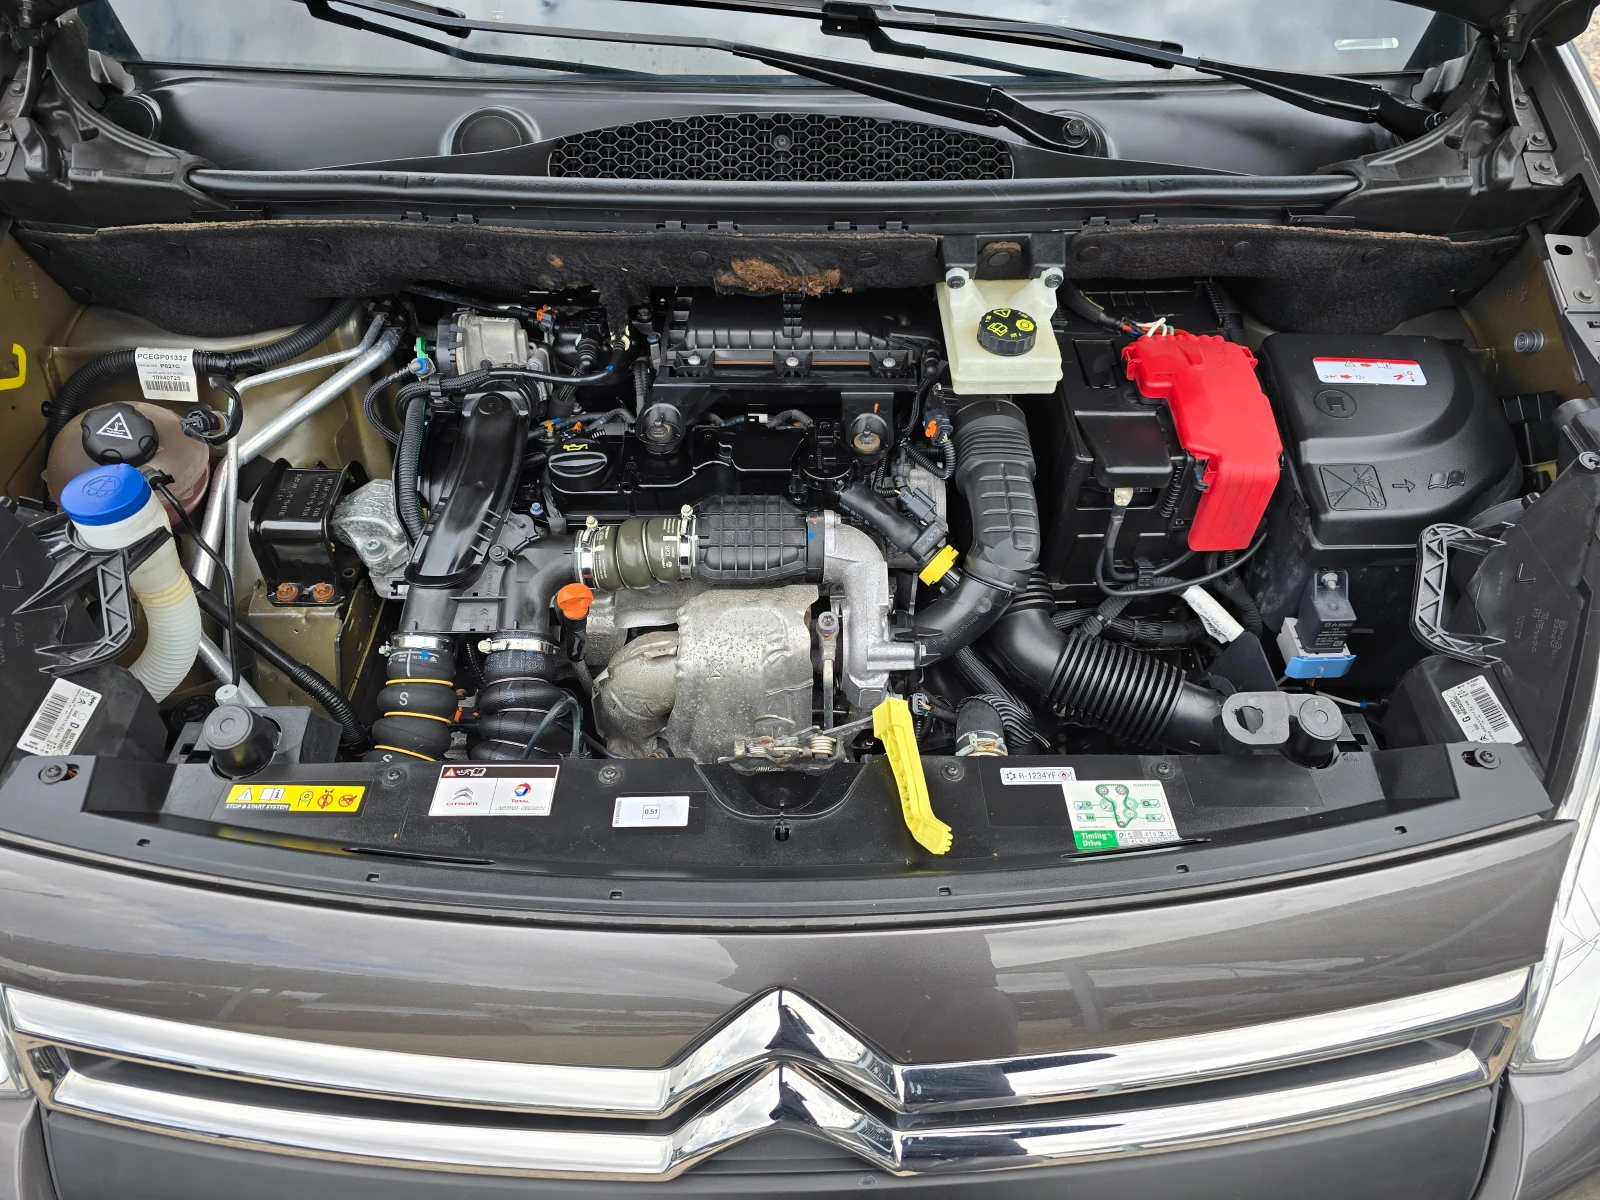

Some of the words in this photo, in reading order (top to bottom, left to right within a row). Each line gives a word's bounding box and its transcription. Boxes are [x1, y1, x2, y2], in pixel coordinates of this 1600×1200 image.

[399, 691, 409, 706] S
[1018, 771, 1056, 780] R-1234YF
[1081, 832, 1108, 841] Timing
